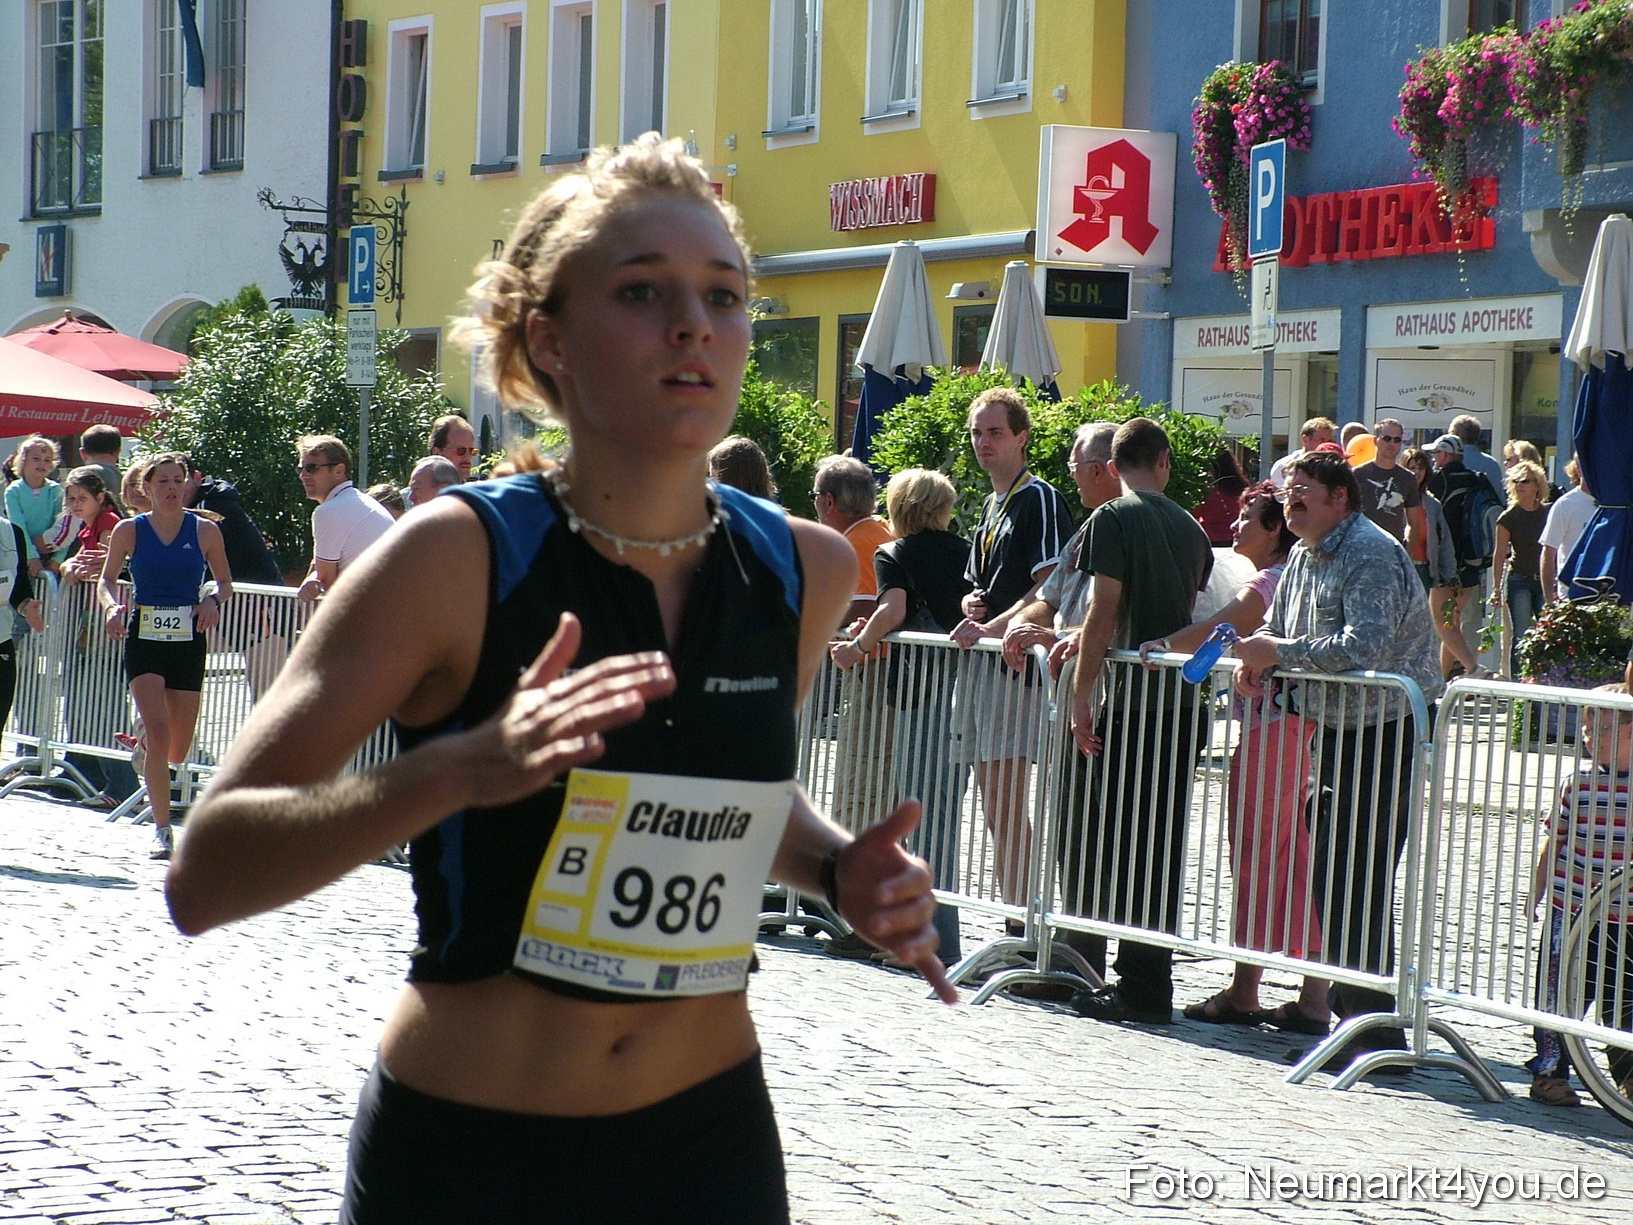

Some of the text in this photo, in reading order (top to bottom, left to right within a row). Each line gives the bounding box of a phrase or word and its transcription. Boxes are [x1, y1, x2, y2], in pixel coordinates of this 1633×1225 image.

[828, 172, 928, 232] WISSMACH
[1256, 158, 1276, 241] P
[354, 236, 370, 294] P
[1197, 324, 1250, 348] RATHAUS
[1396, 306, 1534, 337] RATHAUS APOTHEKE
[1202, 393, 1221, 403] Haus
[1221, 391, 1234, 399] der
[1398, 383, 1476, 397] Haus der Gesundheit
[8, 405, 78, 422] Restaurant
[143, 613, 149, 621] B
[153, 616, 181, 630] 942
[625, 799, 753, 842] Claudia
[557, 846, 588, 876] B
[608, 865, 727, 936] 986
